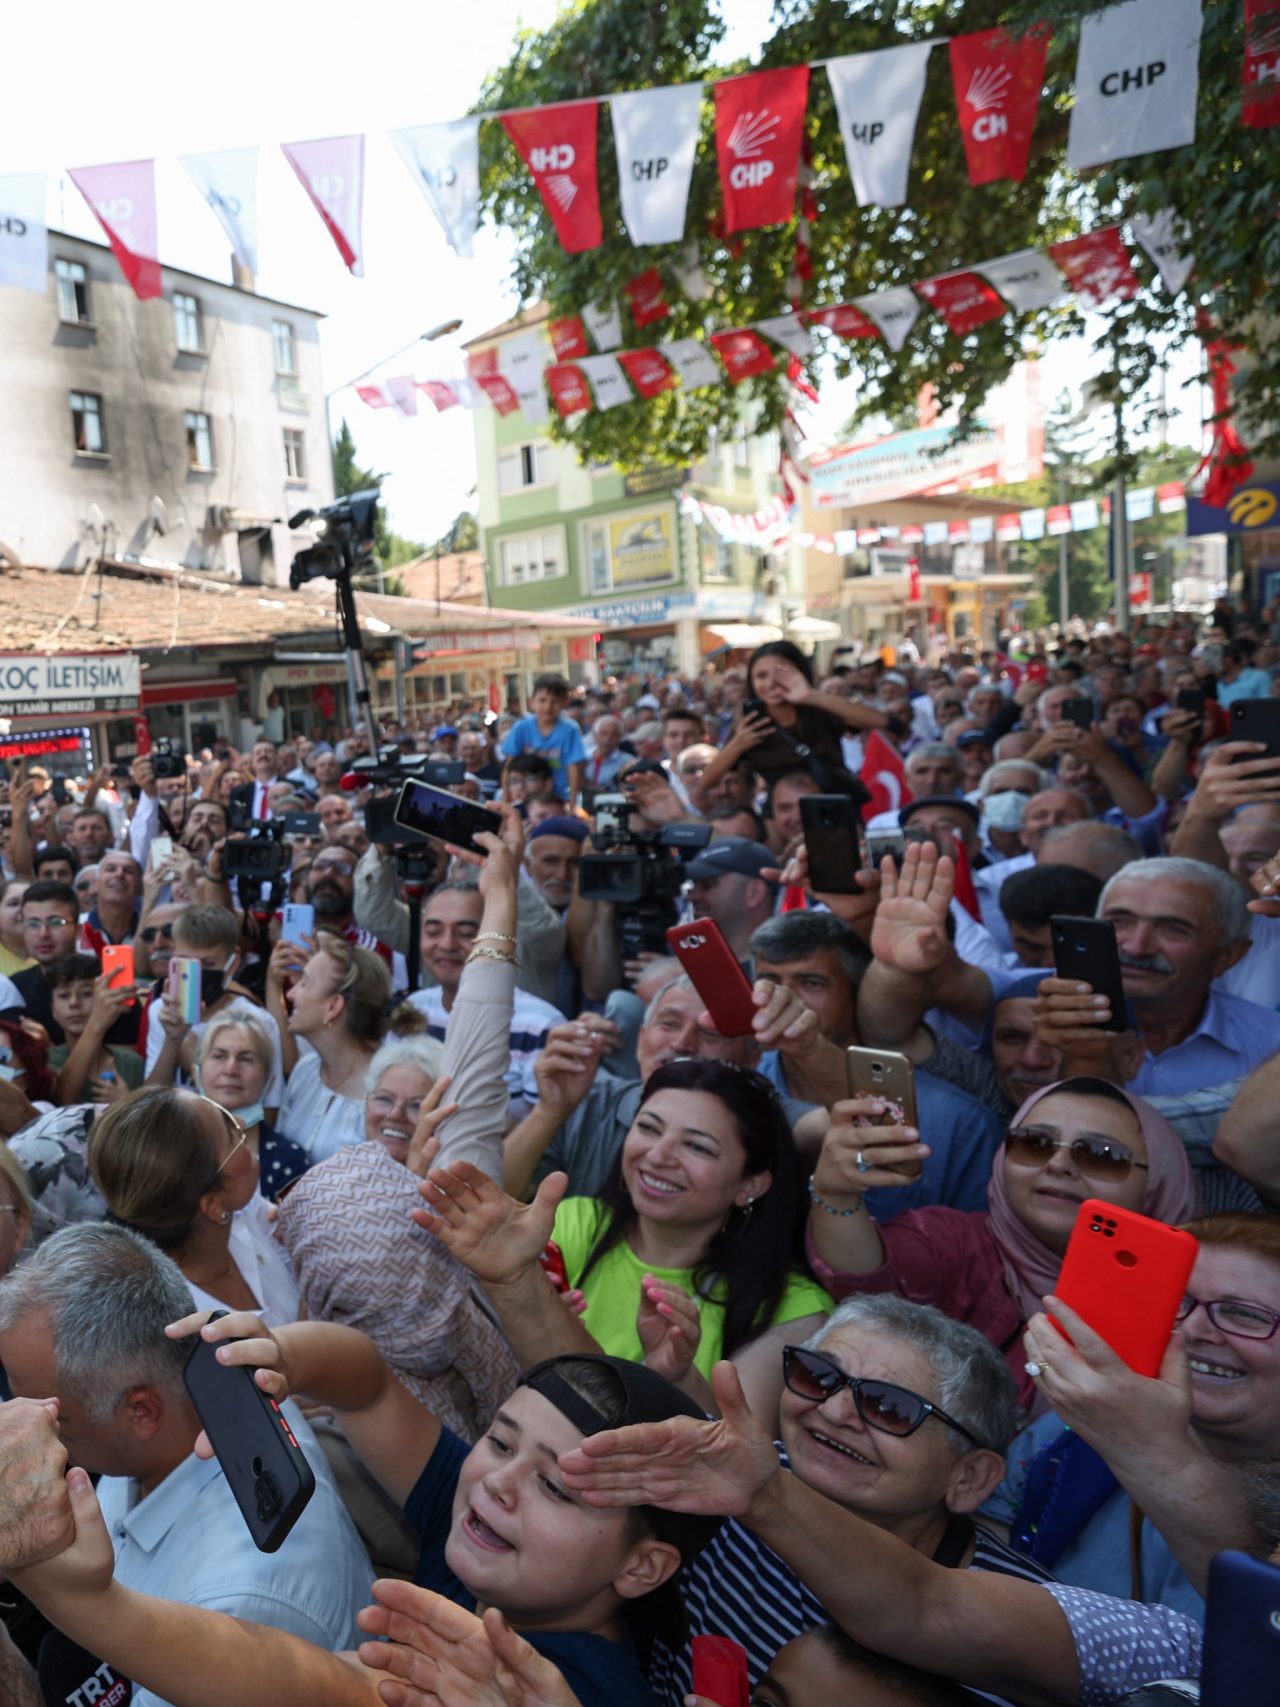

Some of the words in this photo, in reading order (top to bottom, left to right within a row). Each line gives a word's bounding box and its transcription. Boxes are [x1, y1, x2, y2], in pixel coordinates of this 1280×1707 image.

[1100, 60, 1166, 97] CHP
[730, 159, 775, 190] CHP
[47, 658, 123, 692] İLETİŞİM
[65, 1662, 114, 1707] TRT
